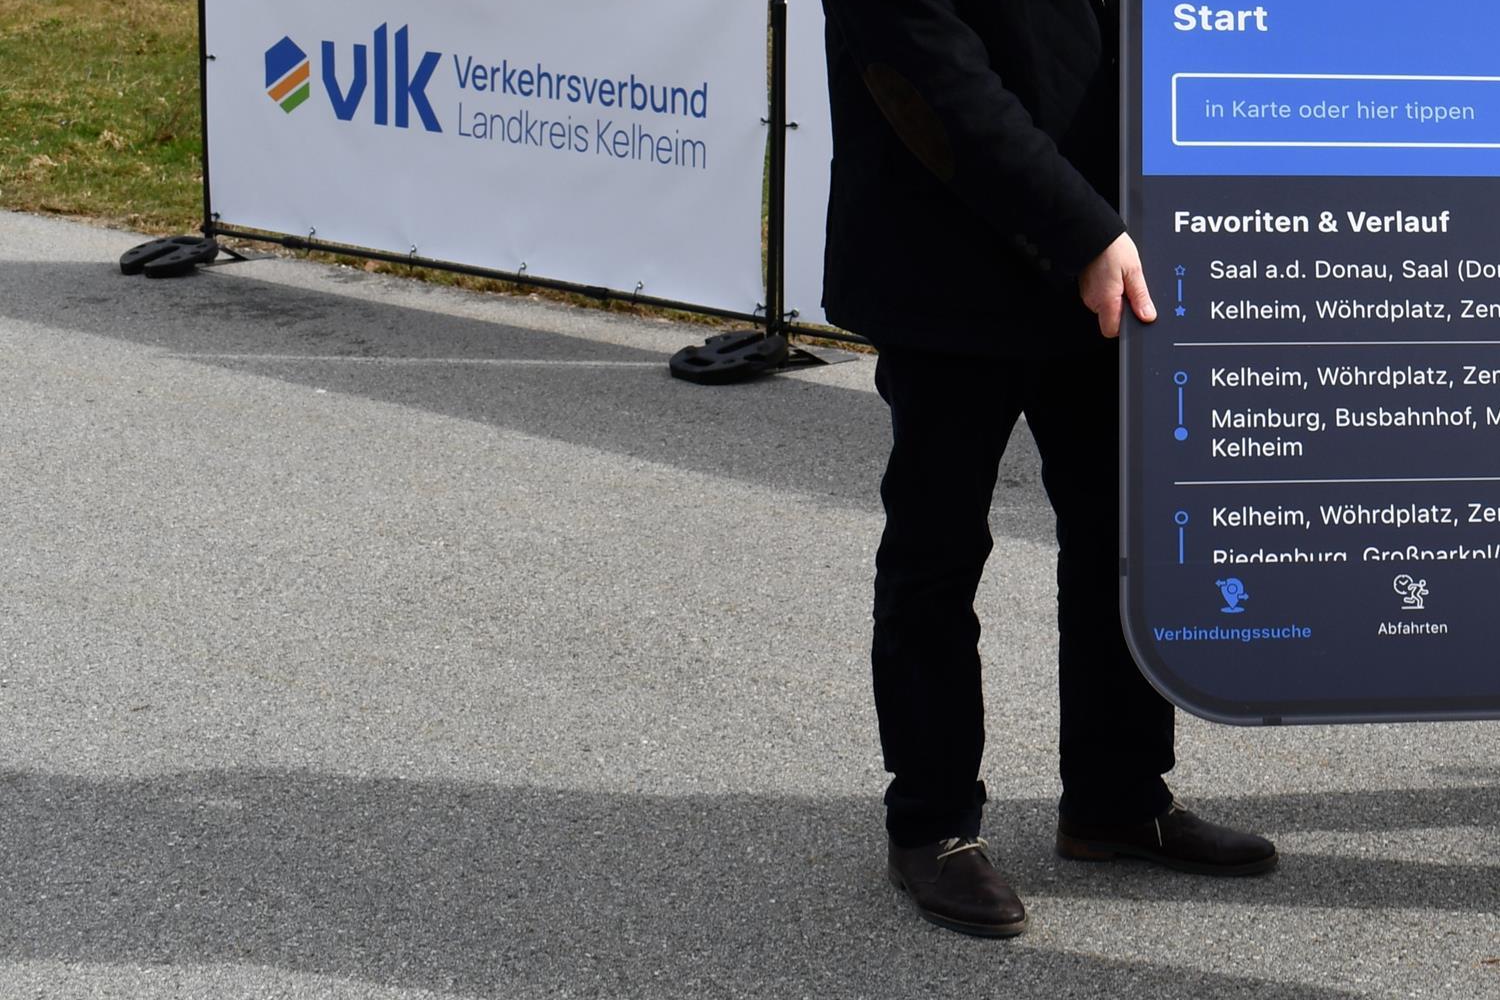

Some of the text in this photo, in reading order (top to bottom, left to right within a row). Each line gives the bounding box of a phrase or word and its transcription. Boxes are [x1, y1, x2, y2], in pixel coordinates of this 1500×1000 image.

[1174, 4, 1268, 32] Start
[321, 22, 443, 133] vlk
[453, 54, 708, 119] Verkehrsverbund
[1205, 100, 1475, 123] in Karte oder hier tippen
[458, 102, 707, 169] Landkreis Kelheim
[1174, 210, 1450, 233] Favoriten & Verlauf
[1210, 260, 1258, 280] Saal
[1265, 260, 1306, 279] a.d.
[1315, 260, 1393, 283] Donau,
[1402, 260, 1449, 279] Saal
[1210, 300, 1307, 323] Kelheim,
[1315, 299, 1452, 323] Wöhrdplatz,
[1211, 367, 1308, 390] Kelheim,
[1316, 366, 1454, 390] Wöhrdplatz,
[1211, 408, 1326, 432] Mainburg,
[1335, 406, 1477, 430] Busbahnhof,
[1212, 437, 1303, 458] Kelheim
[1212, 506, 1311, 530] Kelheim,
[1319, 504, 1459, 528] Wöhrdplatz,
[1153, 625, 1312, 643] Verbindungssuche
[1377, 621, 1448, 635] Abfahrten
